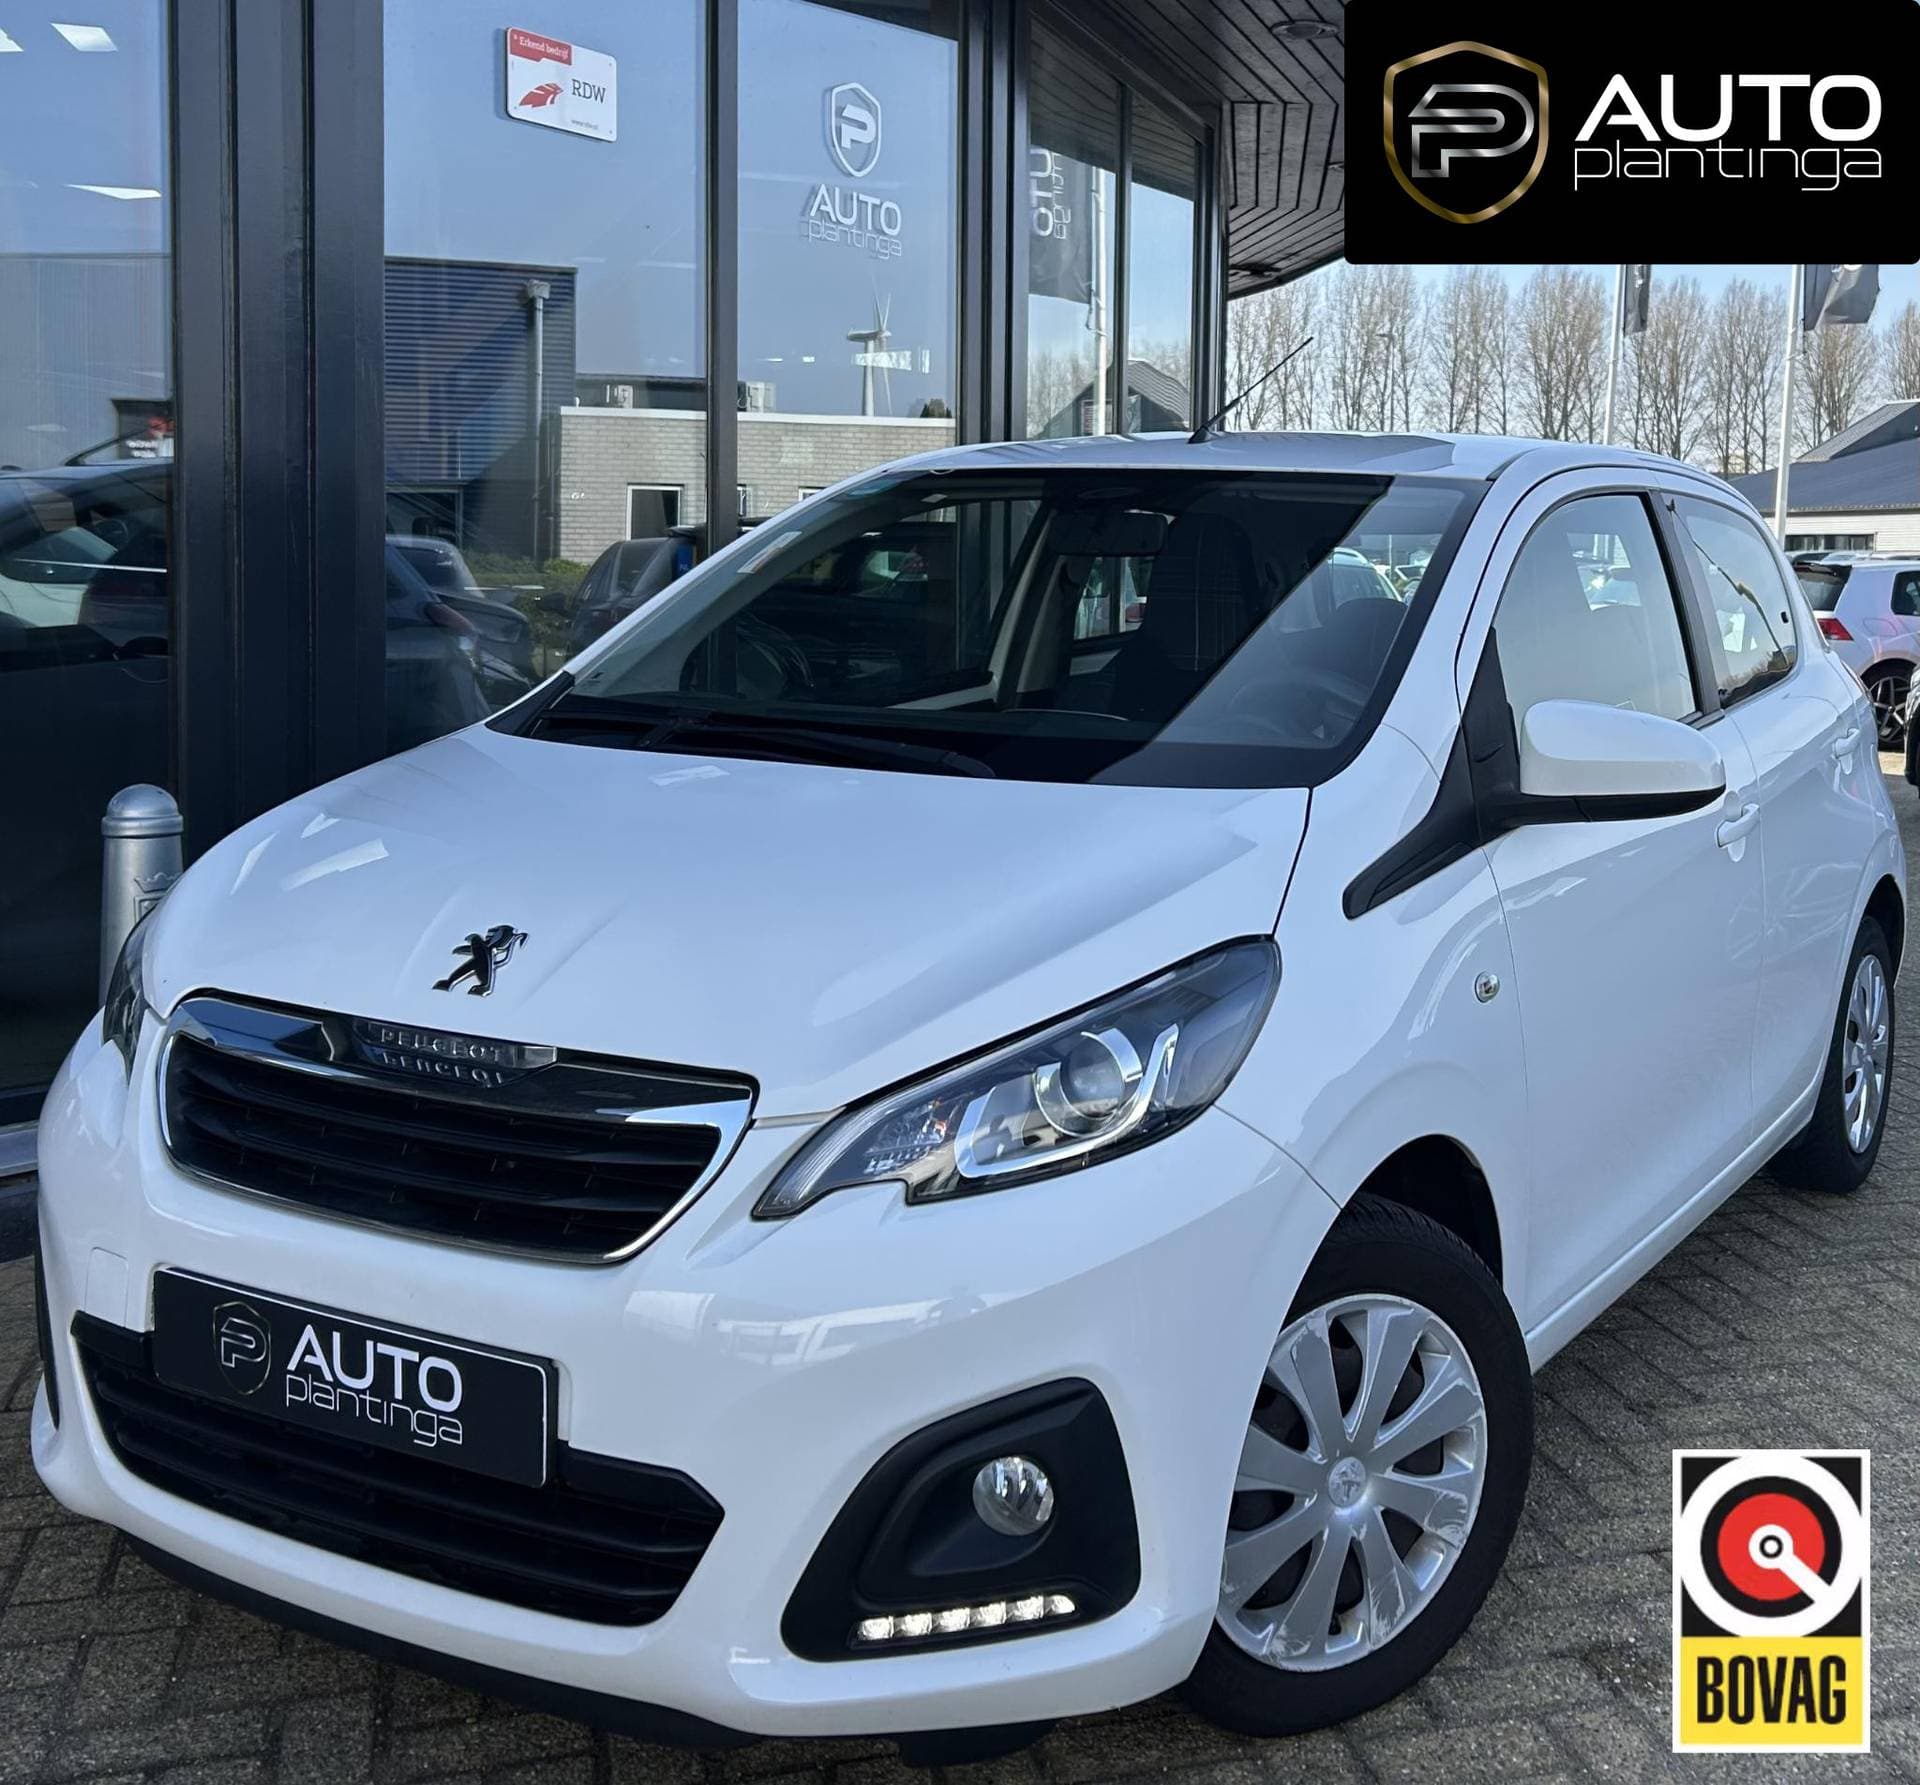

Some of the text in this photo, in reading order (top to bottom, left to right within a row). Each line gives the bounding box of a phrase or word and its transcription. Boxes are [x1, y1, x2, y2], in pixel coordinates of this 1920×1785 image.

[571, 78, 606, 104] RDW
[810, 184, 901, 236] AUTO
[808, 218, 902, 260] plantinga
[381, 1027, 500, 1063] PEUGEOT
[286, 1324, 463, 1413] AUTO
[286, 1373, 463, 1447] plantinga
